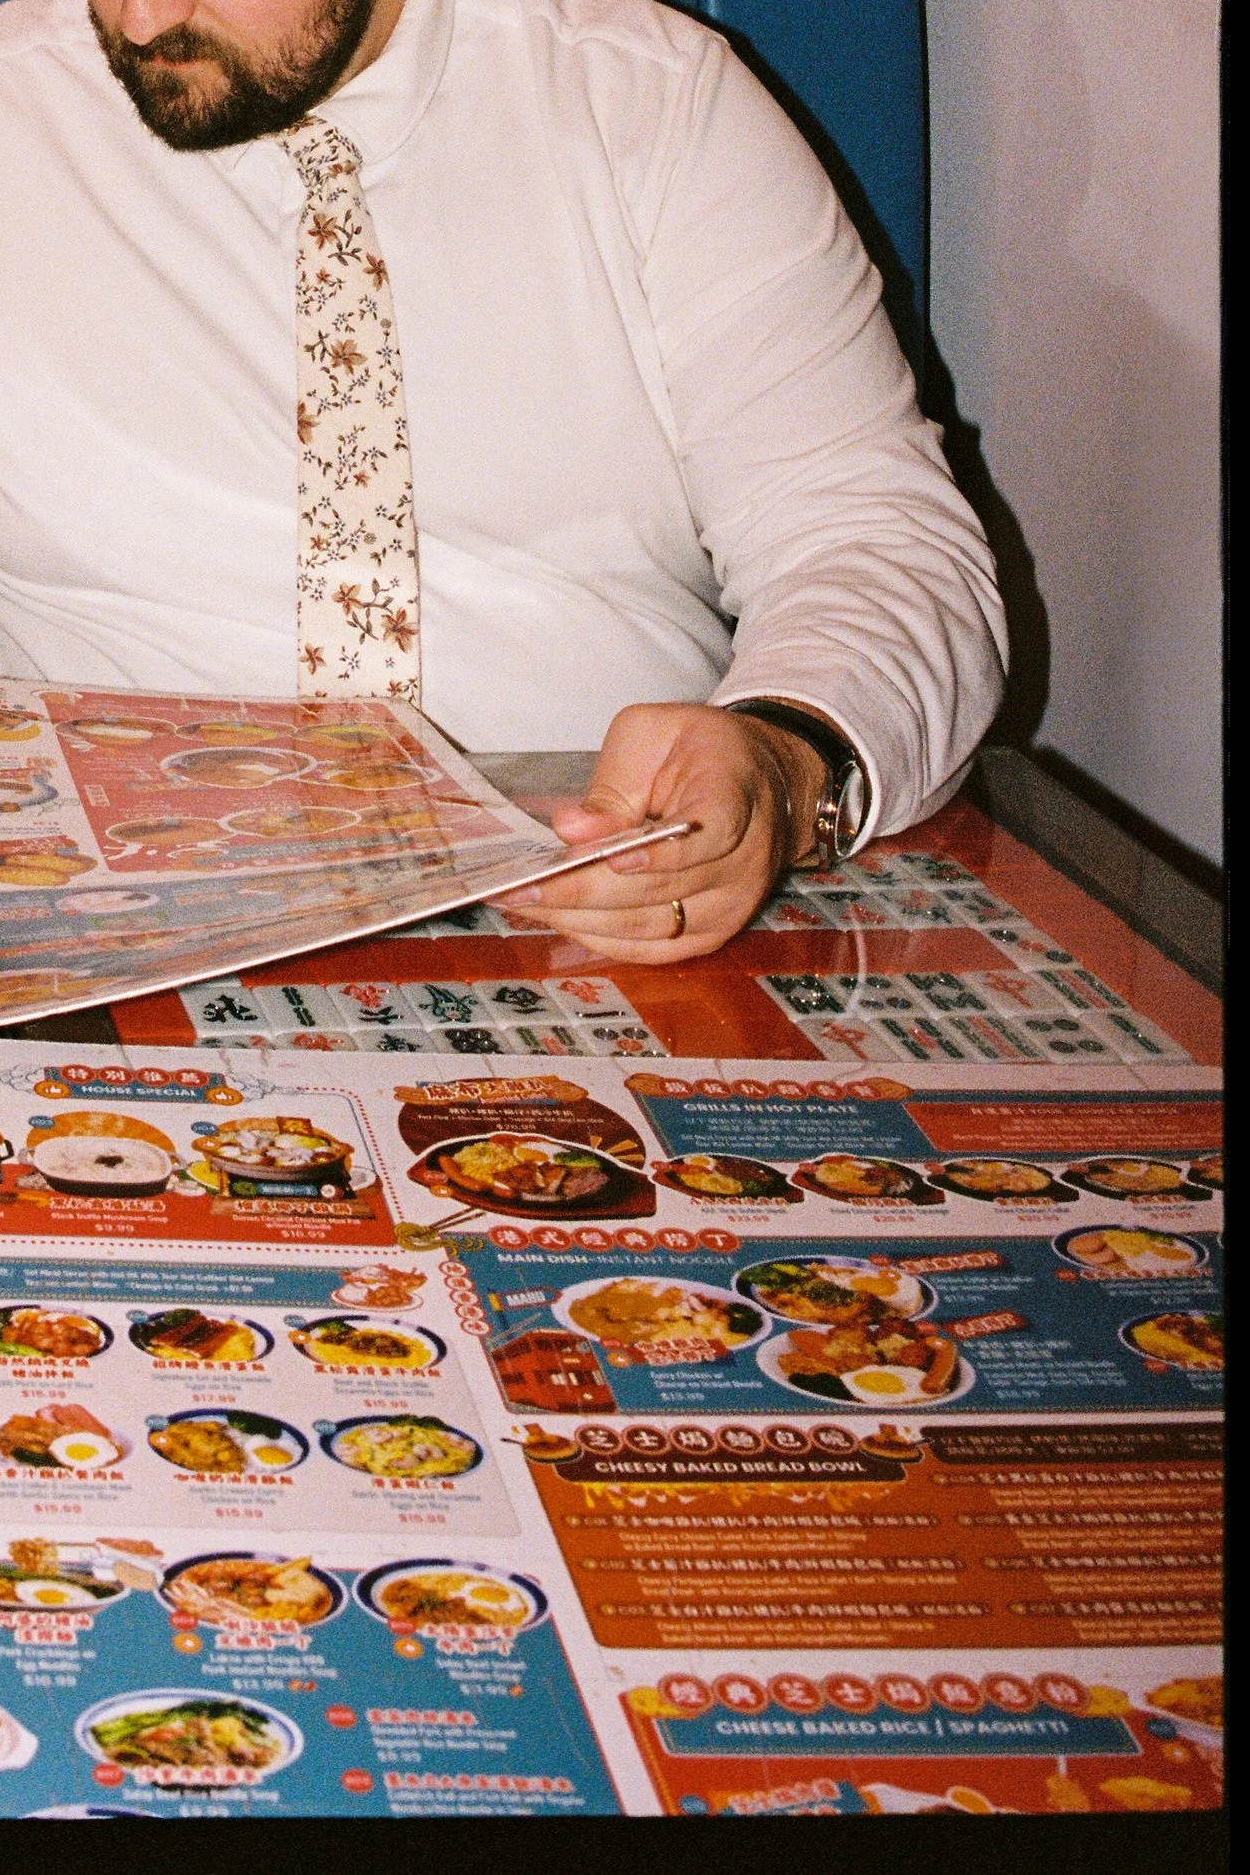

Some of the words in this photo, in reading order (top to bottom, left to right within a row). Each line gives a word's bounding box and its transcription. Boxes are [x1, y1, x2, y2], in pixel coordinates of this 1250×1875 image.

[82, 1084, 134, 1095] HOUSE
[136, 1086, 197, 1097] SPECIAL
[683, 1102, 742, 1113] GRILLS
[745, 1103, 764, 1113] IN
[766, 1103, 802, 1113] HOT
[804, 1103, 859, 1114] PLATE
[497, 1253, 544, 1264] MAIN
[668, 1255, 737, 1266] NOODLE
[595, 1461, 668, 1473] CHEESY
[672, 1461, 738, 1473] BAKED
[743, 1462, 805, 1473] BREAD
[809, 1462, 868, 1473] BOWL
[715, 1720, 797, 1734] CHEESE
[803, 1720, 876, 1735] BAKED
[880, 1720, 929, 1735] RICE
[948, 1720, 1069, 1736] SPAGHETTI
